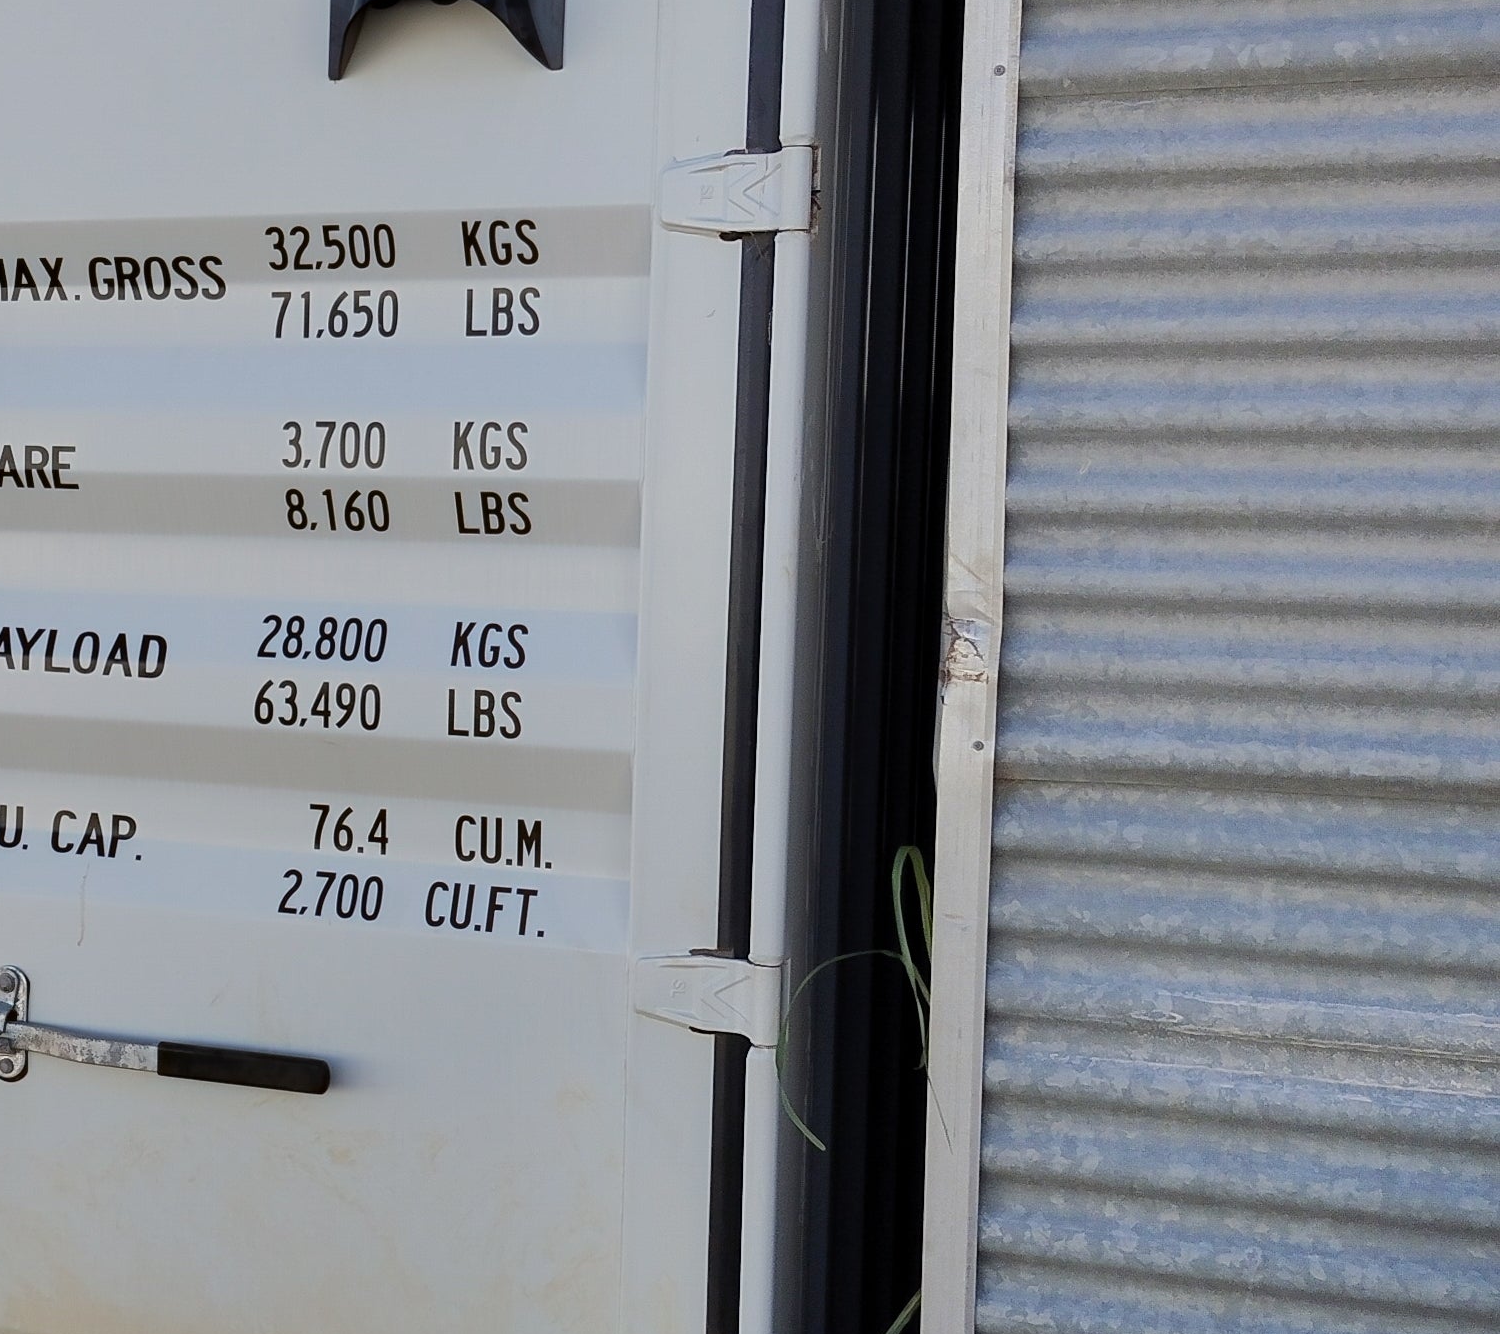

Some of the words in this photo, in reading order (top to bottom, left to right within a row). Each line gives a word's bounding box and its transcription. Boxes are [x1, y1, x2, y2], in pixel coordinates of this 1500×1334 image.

[264, 223, 396, 271] 32,500
[461, 219, 539, 267] KGS
[271, 289, 399, 339] 71,650
[465, 287, 541, 337] LBS
[282, 421, 386, 469] 3,700
[453, 421, 528, 471] KGS
[285, 488, 390, 532] 8,160
[454, 491, 532, 535] LBS
[256, 614, 388, 663] 28,800
[450, 621, 529, 670] KGS
[254, 679, 381, 731] 63,490
[447, 688, 522, 740] LBS
[50, 809, 143, 861] CAP.
[309, 803, 389, 856] 76.4
[455, 814, 553, 869] CU.M.
[277, 869, 384, 922] 2,700
[425, 881, 546, 938] CU.FT.
